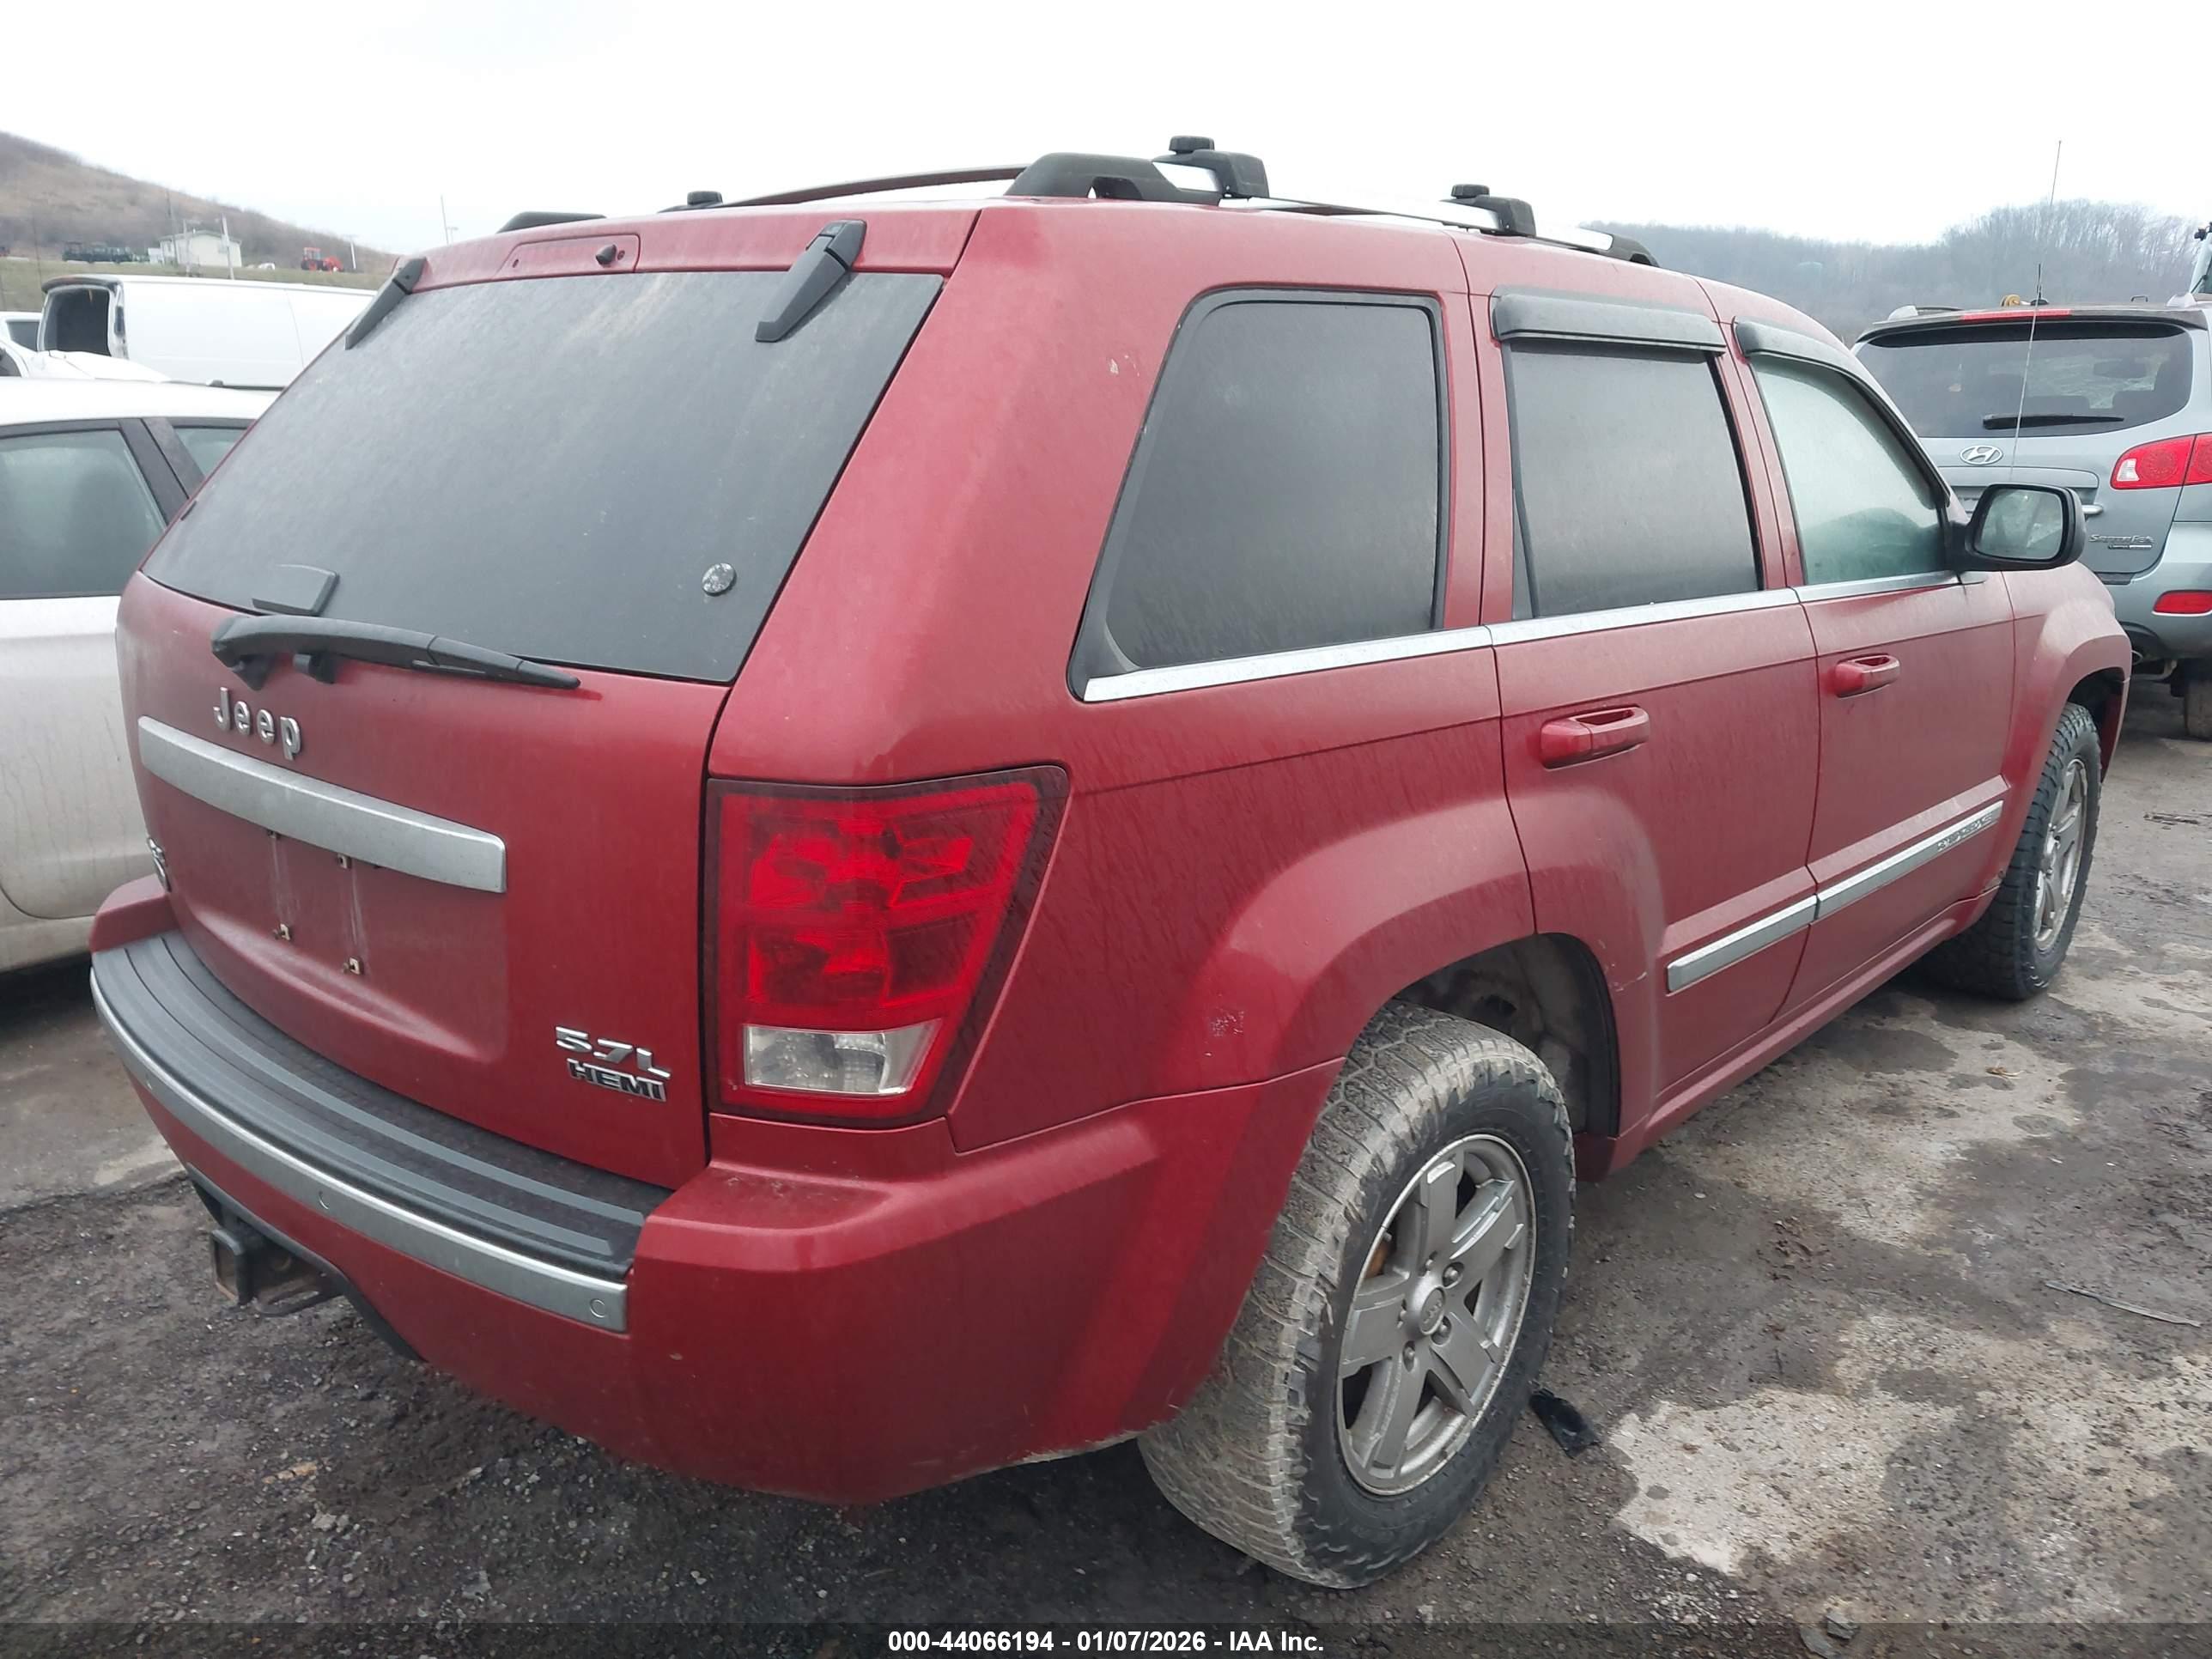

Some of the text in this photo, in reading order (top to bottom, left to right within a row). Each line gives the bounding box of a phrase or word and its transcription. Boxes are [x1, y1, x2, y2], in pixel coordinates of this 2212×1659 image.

[213, 687, 301, 762] Jeep
[556, 1026, 672, 1079] 5.7L
[567, 1058, 666, 1102] HEMI
